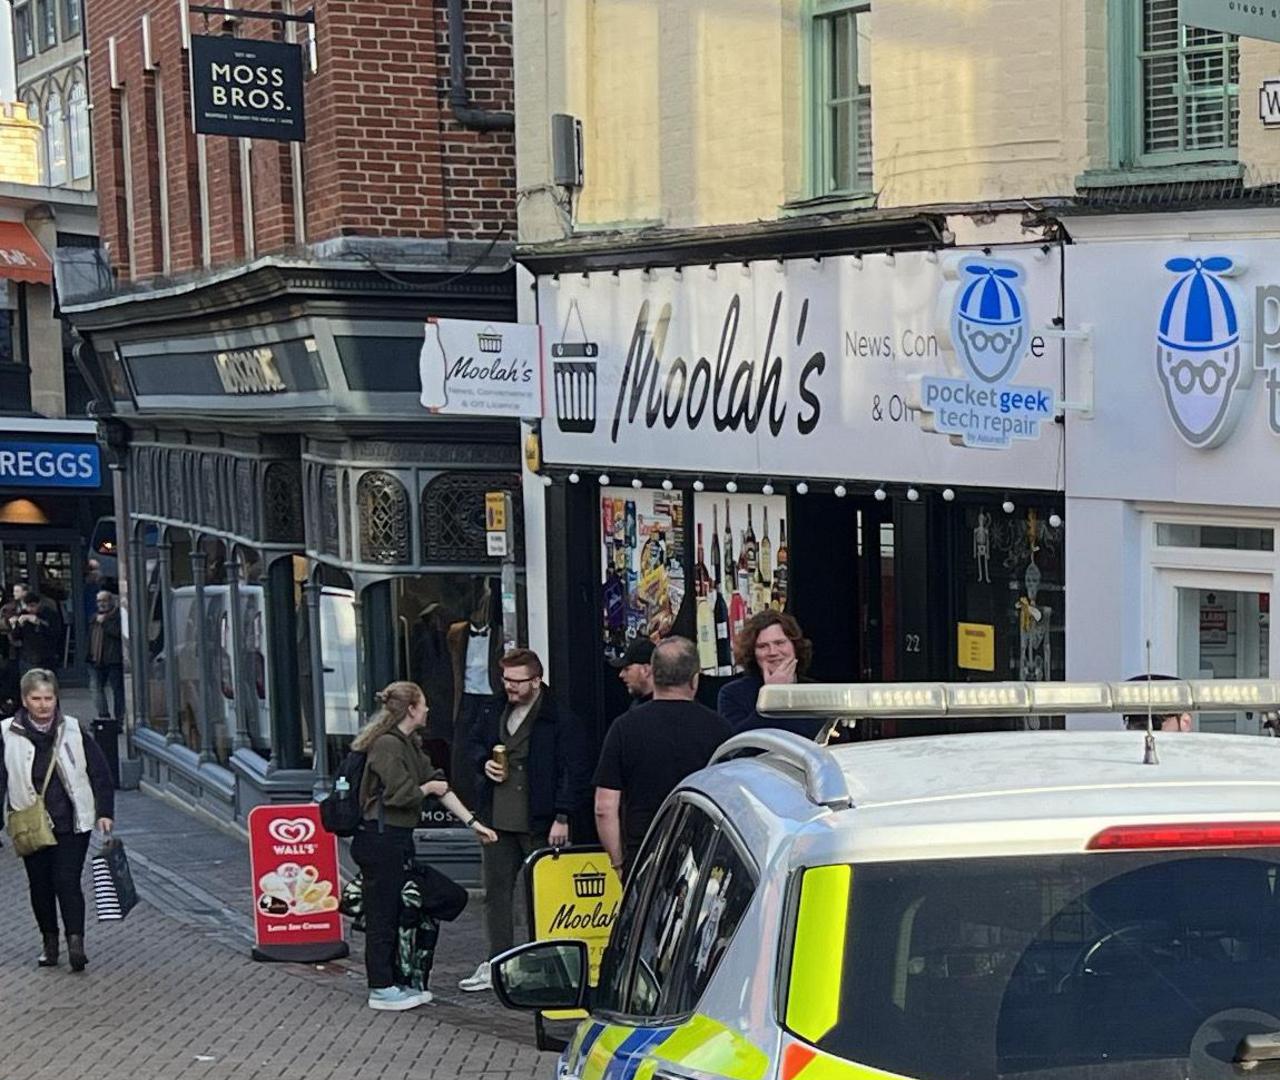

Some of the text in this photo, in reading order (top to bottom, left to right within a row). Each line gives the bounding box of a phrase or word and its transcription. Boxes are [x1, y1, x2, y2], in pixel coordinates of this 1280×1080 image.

[211, 62, 284, 87] MOSS
[212, 85, 292, 111] BROS.
[845, 330, 897, 361] News,
[445, 356, 533, 383] Moolah's
[609, 289, 826, 443] Moolah's
[926, 384, 1049, 413] pocket geek
[940, 407, 1037, 436] tech repair
[906, 633, 920, 652] 22
